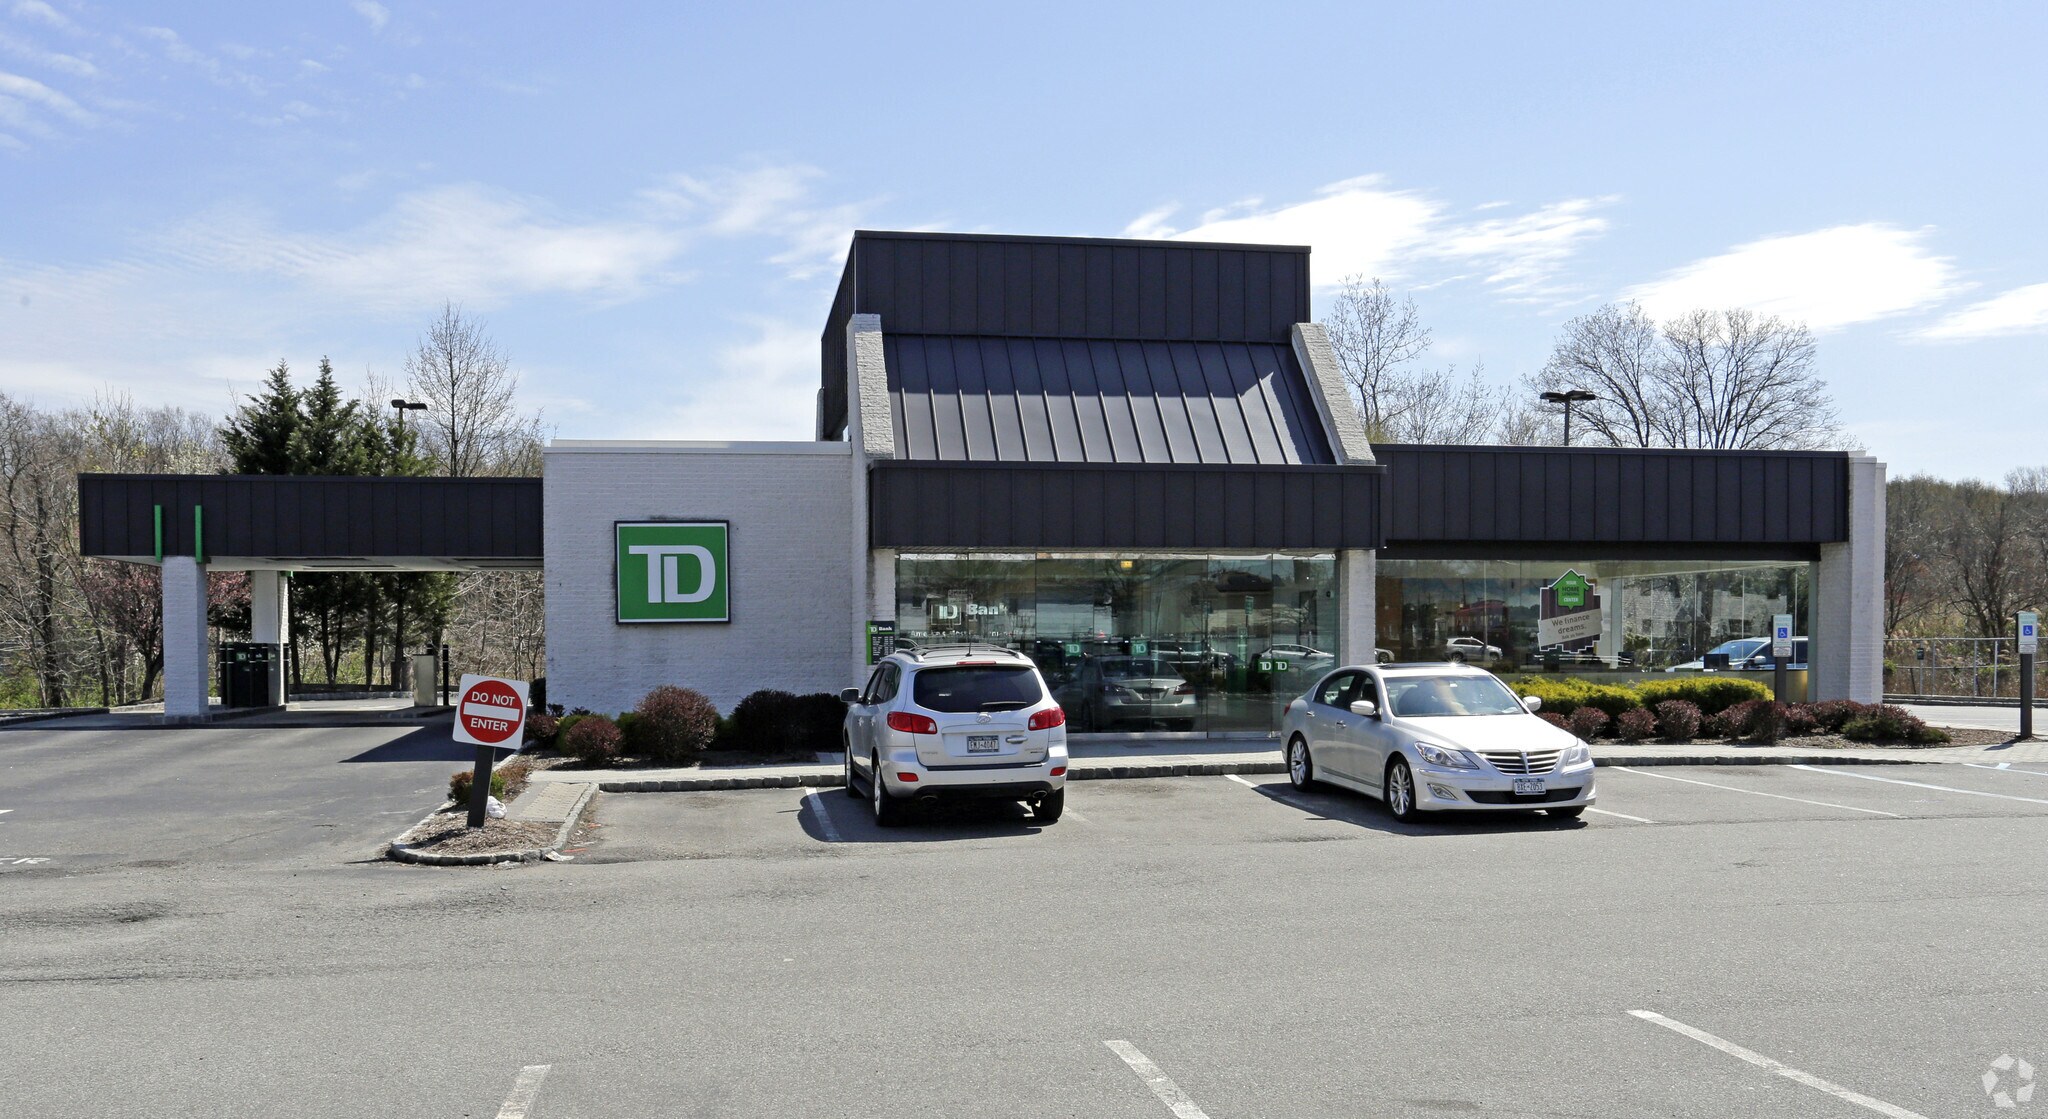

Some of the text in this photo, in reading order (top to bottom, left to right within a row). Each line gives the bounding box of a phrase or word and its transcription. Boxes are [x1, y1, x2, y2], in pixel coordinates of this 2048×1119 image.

[628, 545, 716, 603] TD
[1565, 615, 1590, 624] finance
[1066, 644, 1080, 653] TD
[1260, 661, 1272, 671] TD
[1275, 661, 1288, 671] TD
[471, 691, 516, 706] DO NOT
[470, 718, 508, 731] ENTER
